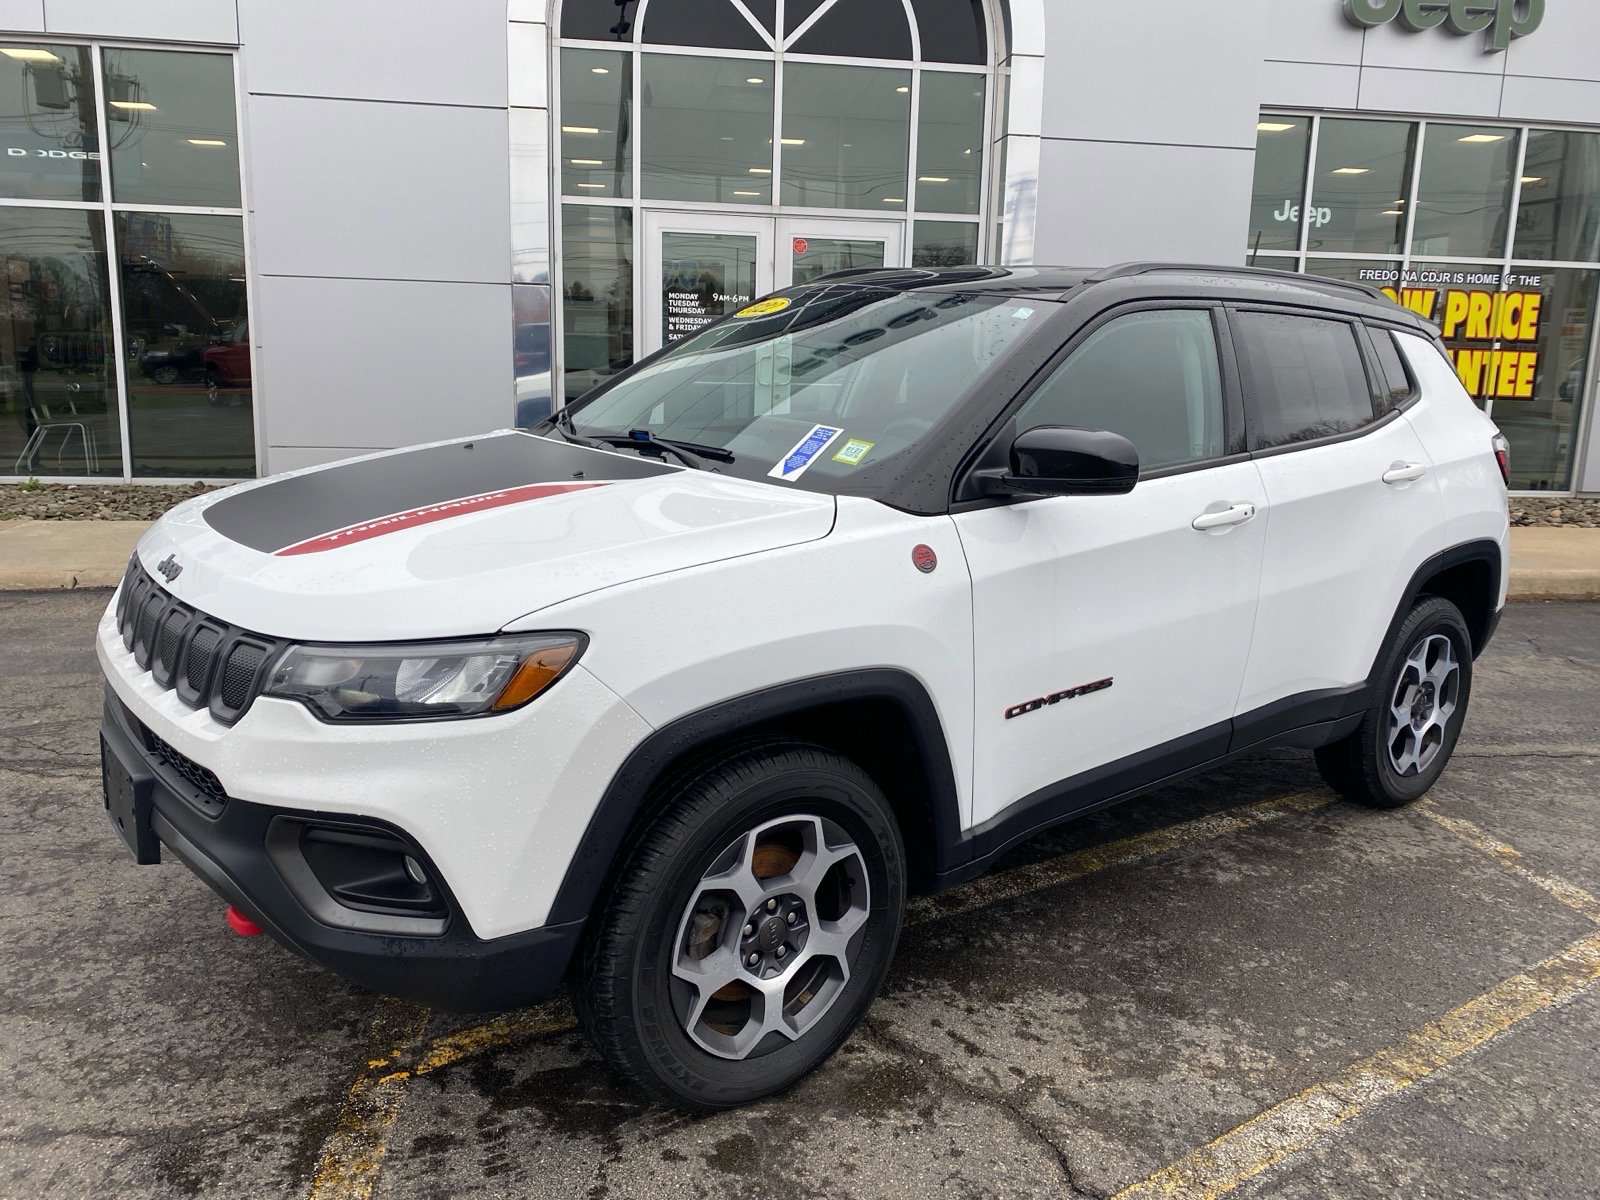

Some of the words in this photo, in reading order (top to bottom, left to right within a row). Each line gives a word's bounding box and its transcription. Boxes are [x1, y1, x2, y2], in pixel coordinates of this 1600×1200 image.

[1421, 272, 1451, 283] CDJR
[1453, 272, 1464, 283] IS
[1466, 273, 1500, 284] HOME
[1519, 275, 1541, 286] THE
[668, 292, 699, 300] MONDAY
[668, 316, 712, 324] WEDNESDAY
[1442, 289, 1543, 341] PRICE
[1005, 676, 1113, 720] COMPASS
